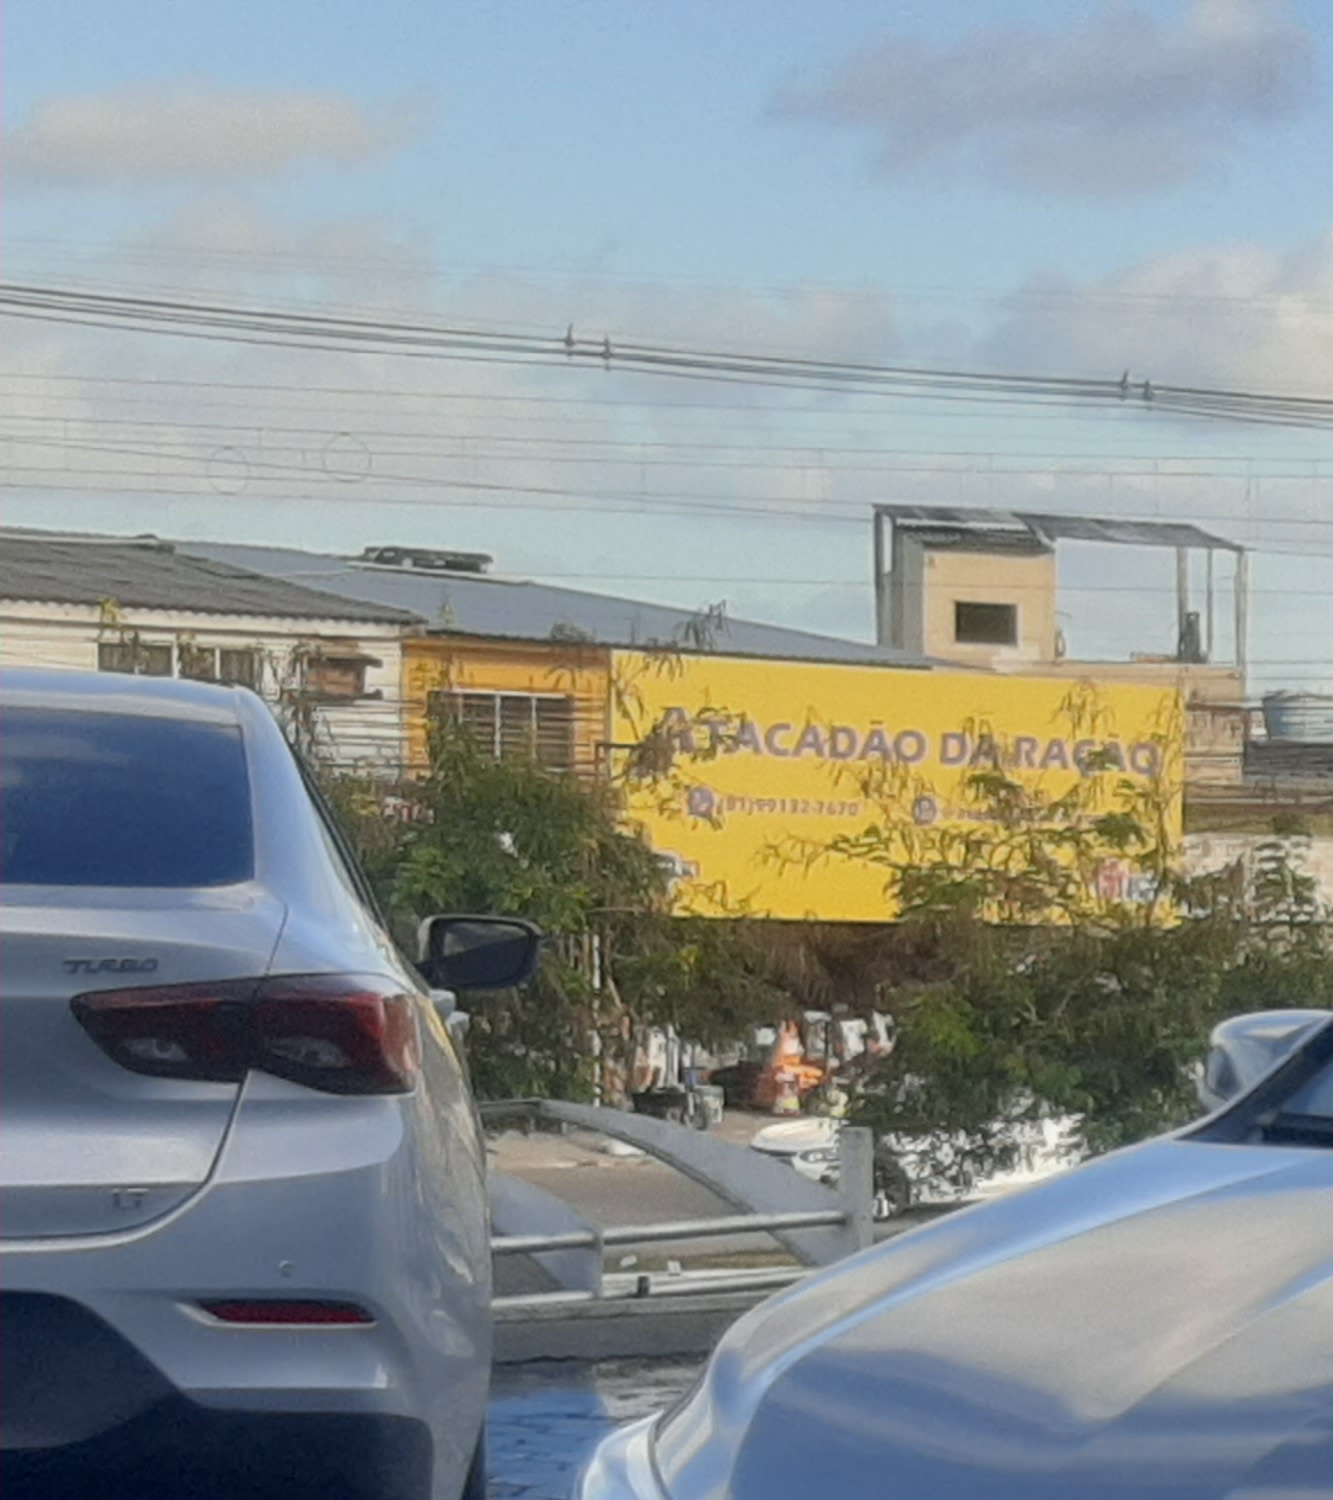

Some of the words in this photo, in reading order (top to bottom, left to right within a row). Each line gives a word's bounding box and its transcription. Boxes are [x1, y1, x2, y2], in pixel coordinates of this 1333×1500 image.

[658, 706, 927, 766] ATACADÃO
[940, 731, 999, 768] DA
[63, 957, 159, 975] TURBO
